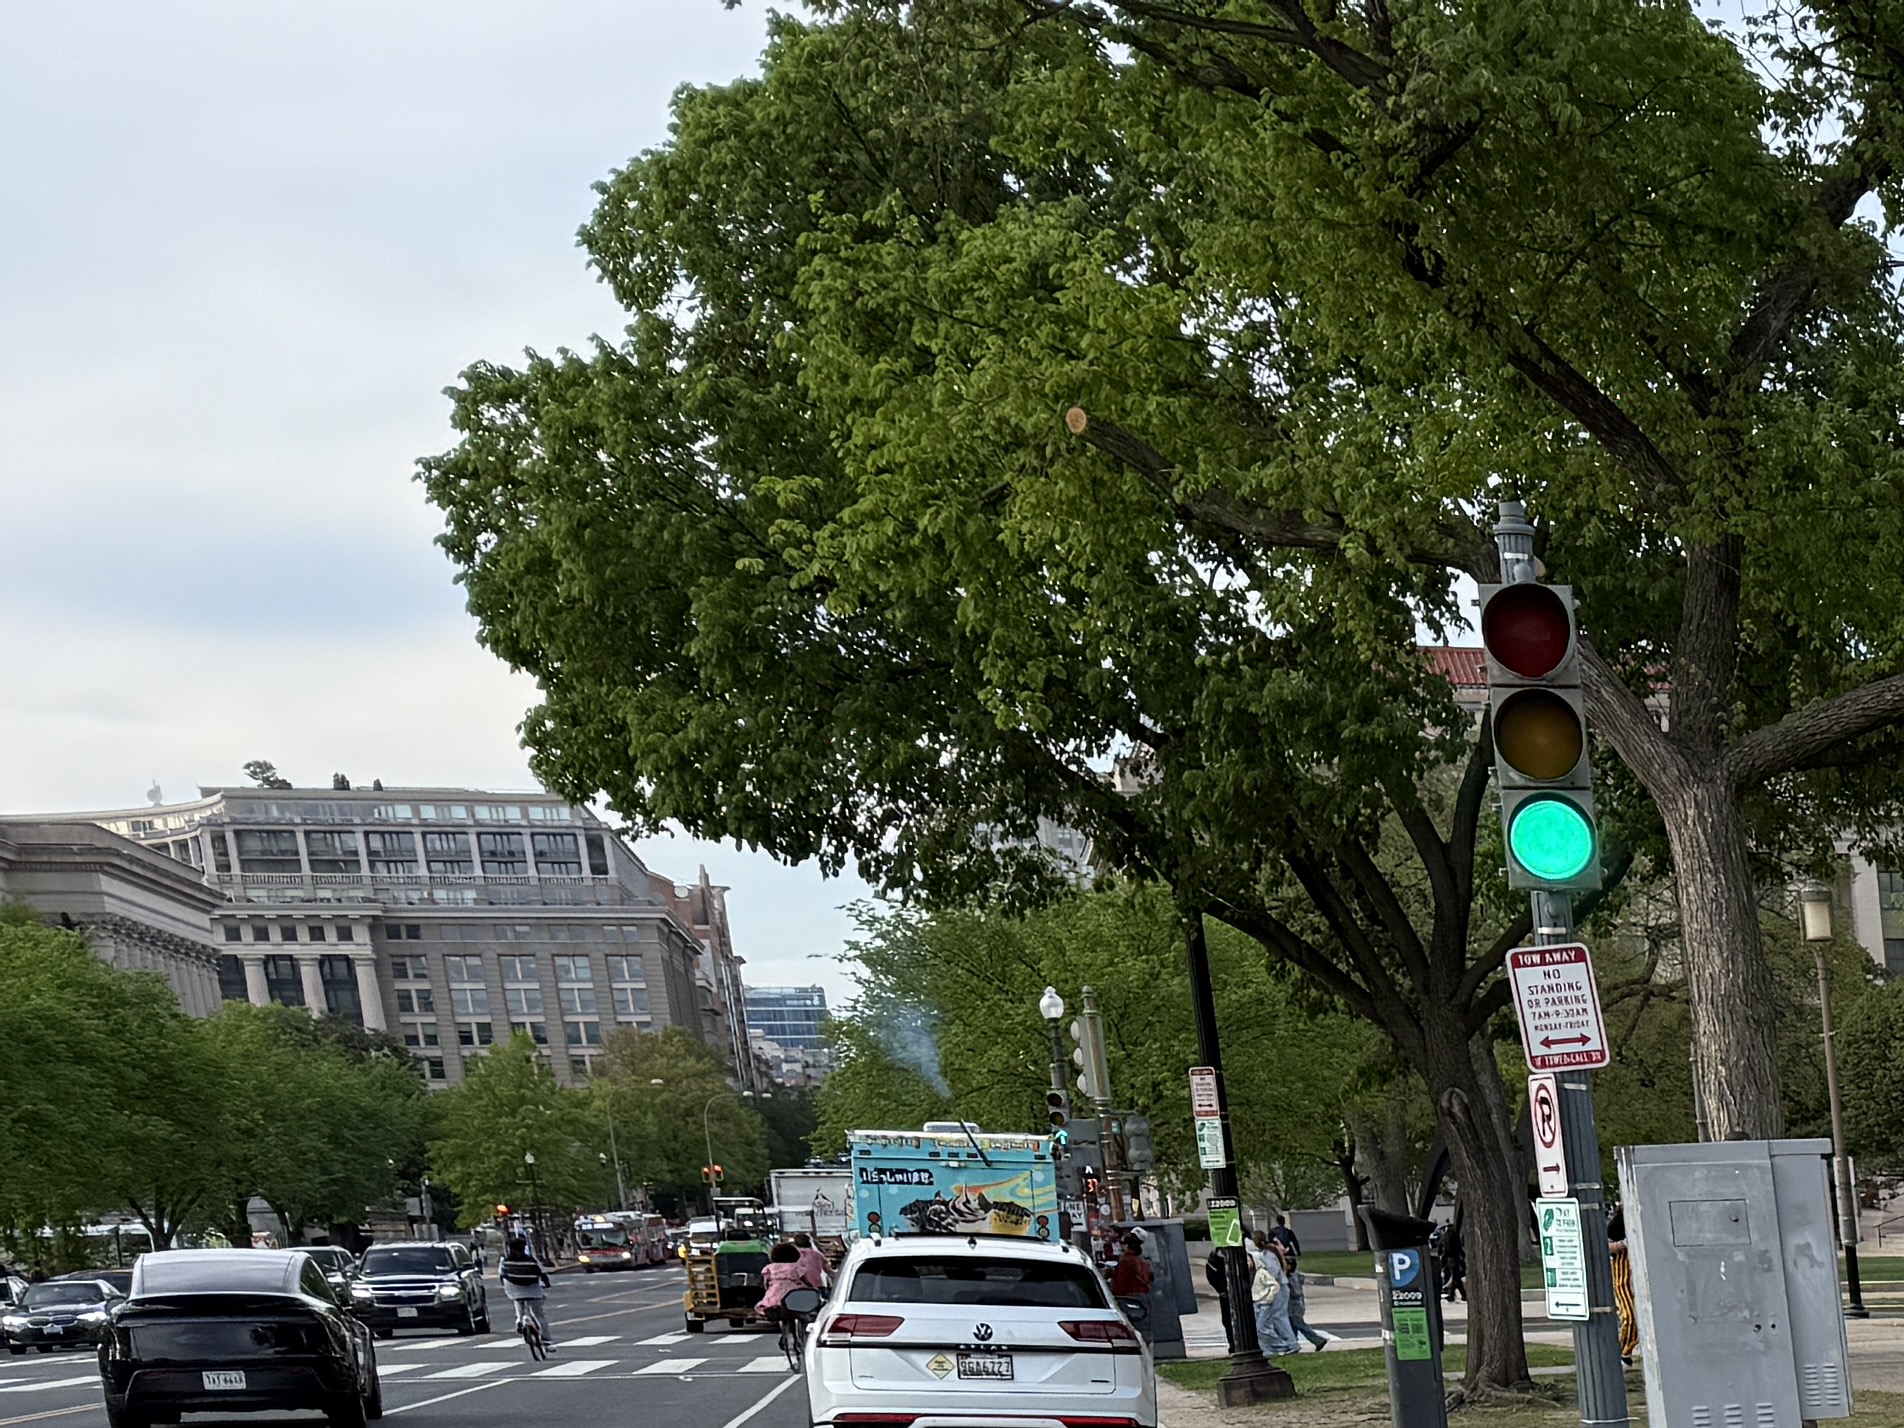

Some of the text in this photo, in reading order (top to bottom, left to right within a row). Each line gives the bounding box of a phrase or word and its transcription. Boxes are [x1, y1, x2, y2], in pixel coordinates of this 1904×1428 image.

[1519, 950, 1576, 966] TOW AWAY
[1543, 968, 1561, 980] NO
[1527, 981, 1582, 996] STANDING
[1545, 994, 1587, 1008] PARKING
[1392, 1253, 1411, 1280] P
